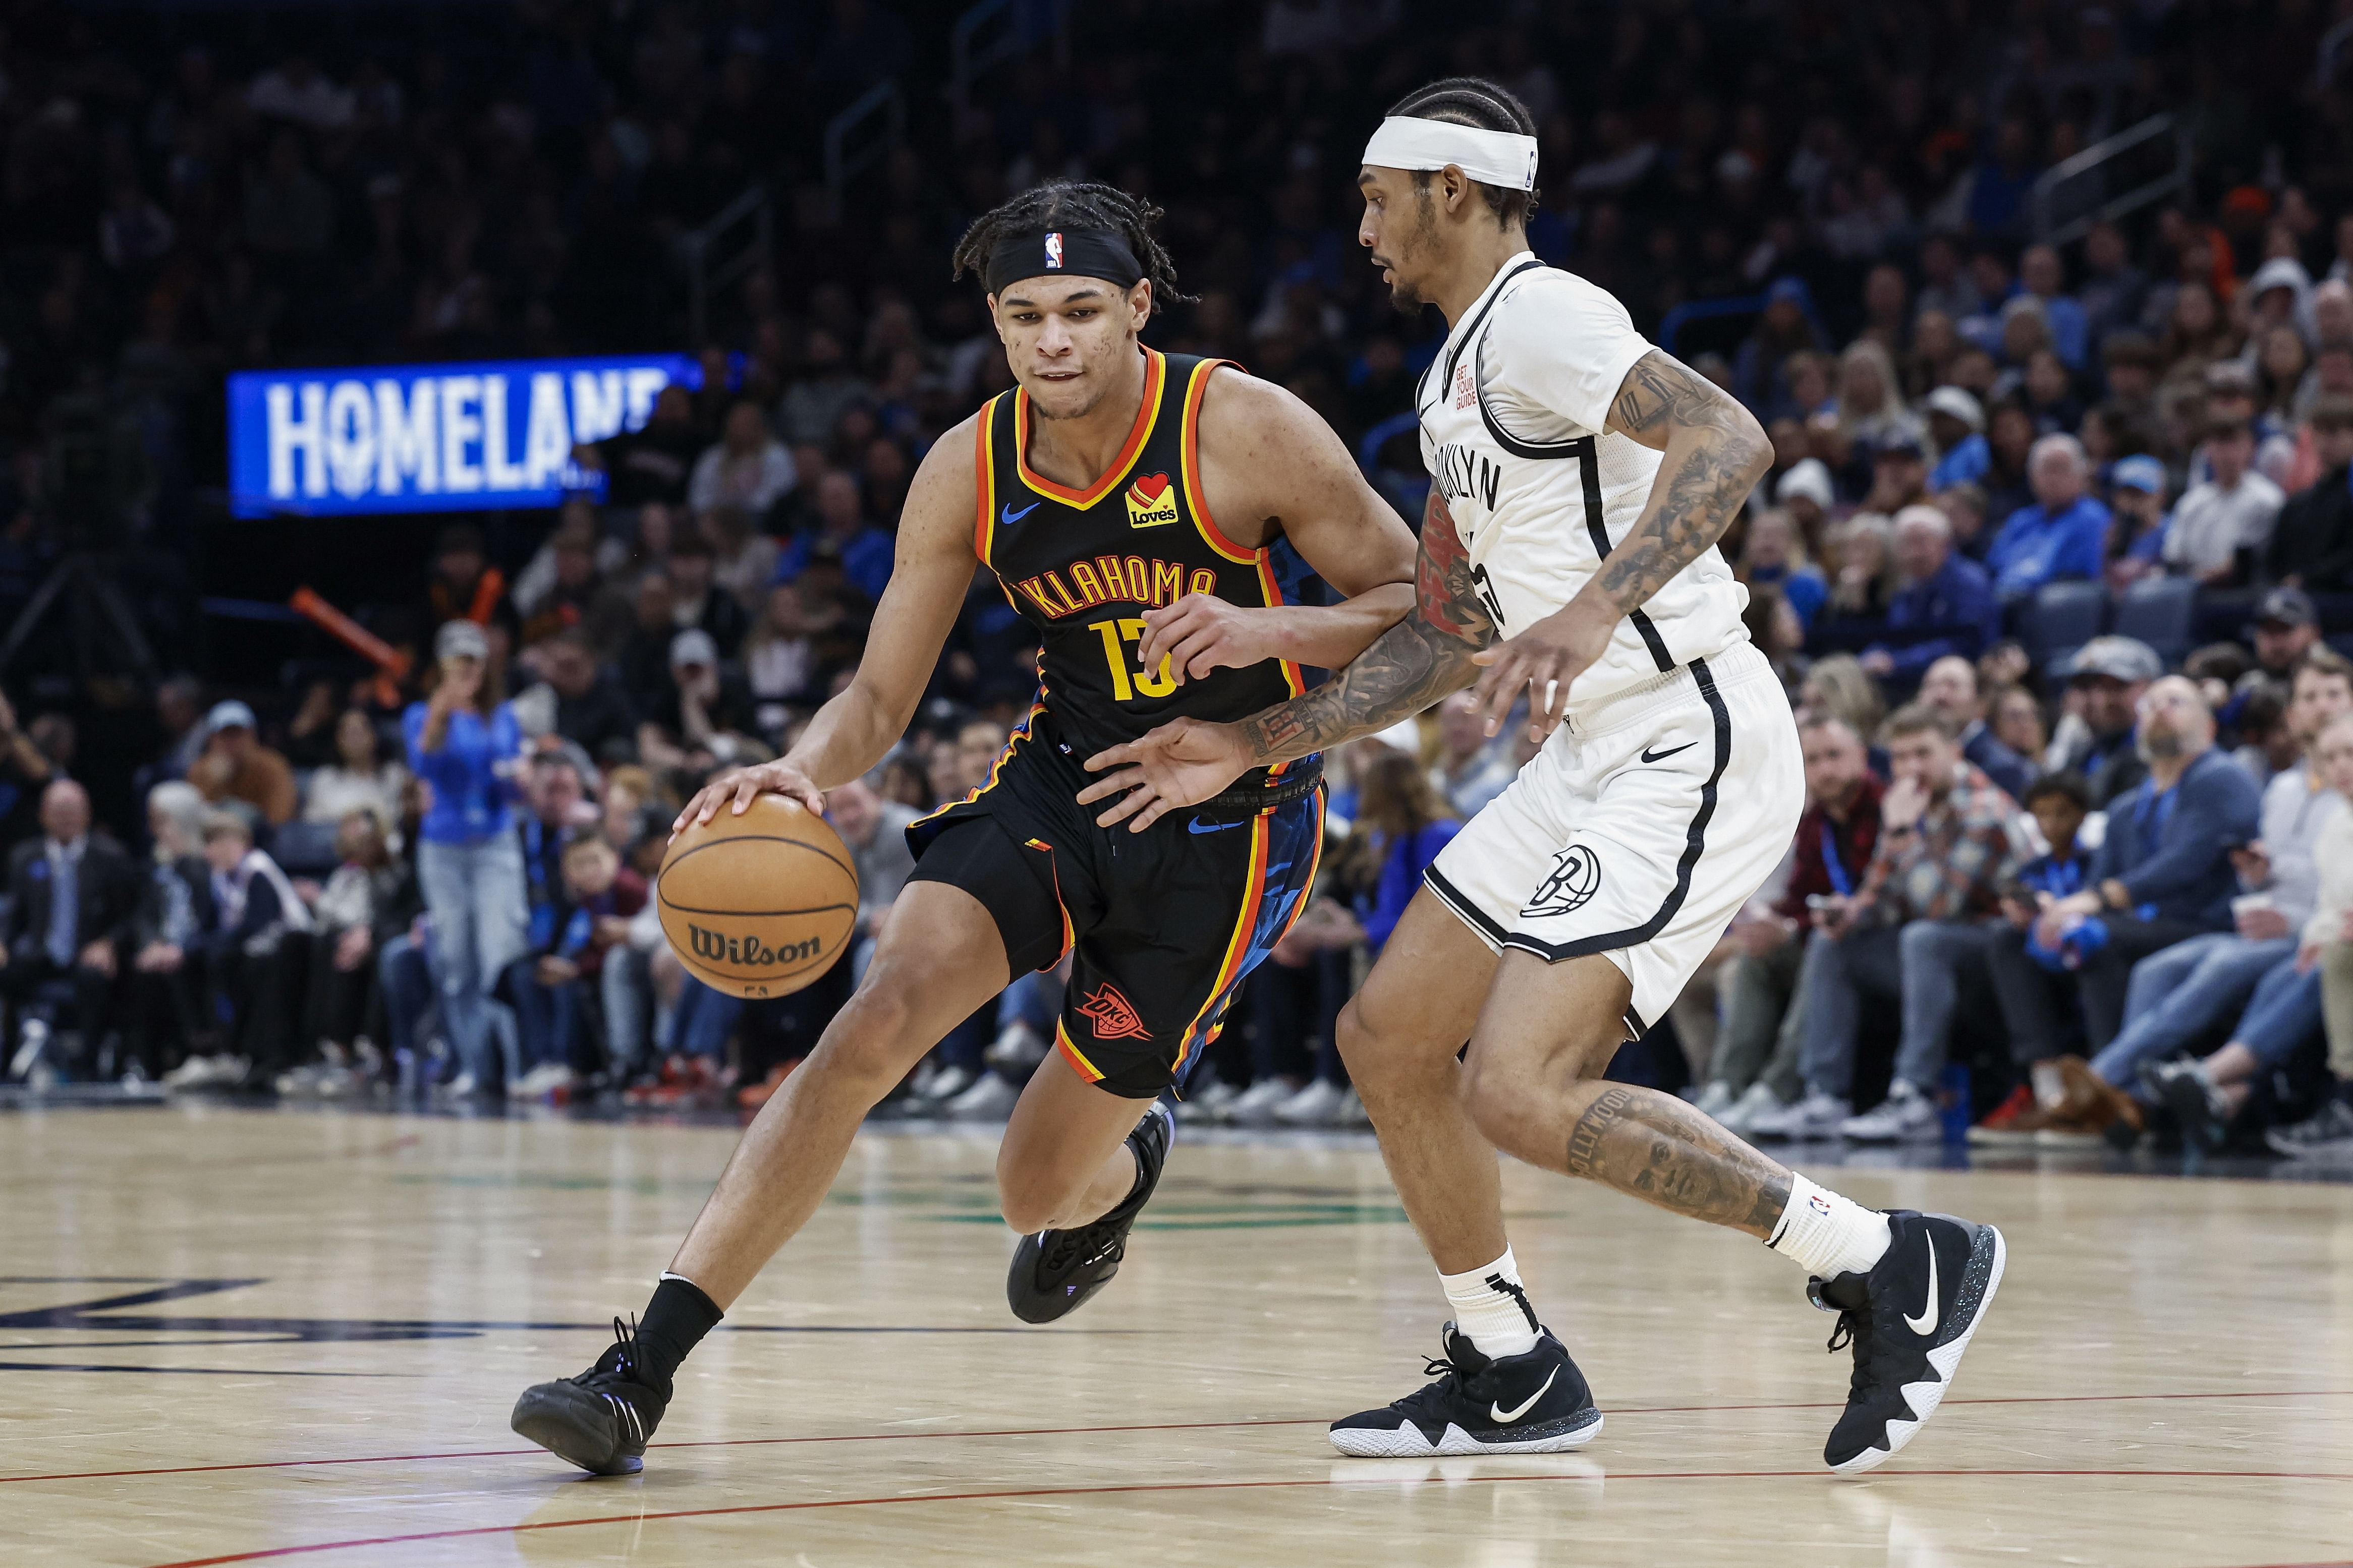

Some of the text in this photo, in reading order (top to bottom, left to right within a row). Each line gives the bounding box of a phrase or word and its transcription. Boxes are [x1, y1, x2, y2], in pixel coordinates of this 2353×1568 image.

[1456, 364, 1467, 381] GET
[1457, 377, 1474, 396] YOUR
[1456, 391, 1477, 411] GUIDE
[1012, 555, 1216, 619] KLAHOMA
[688, 922, 821, 966] Wilson
